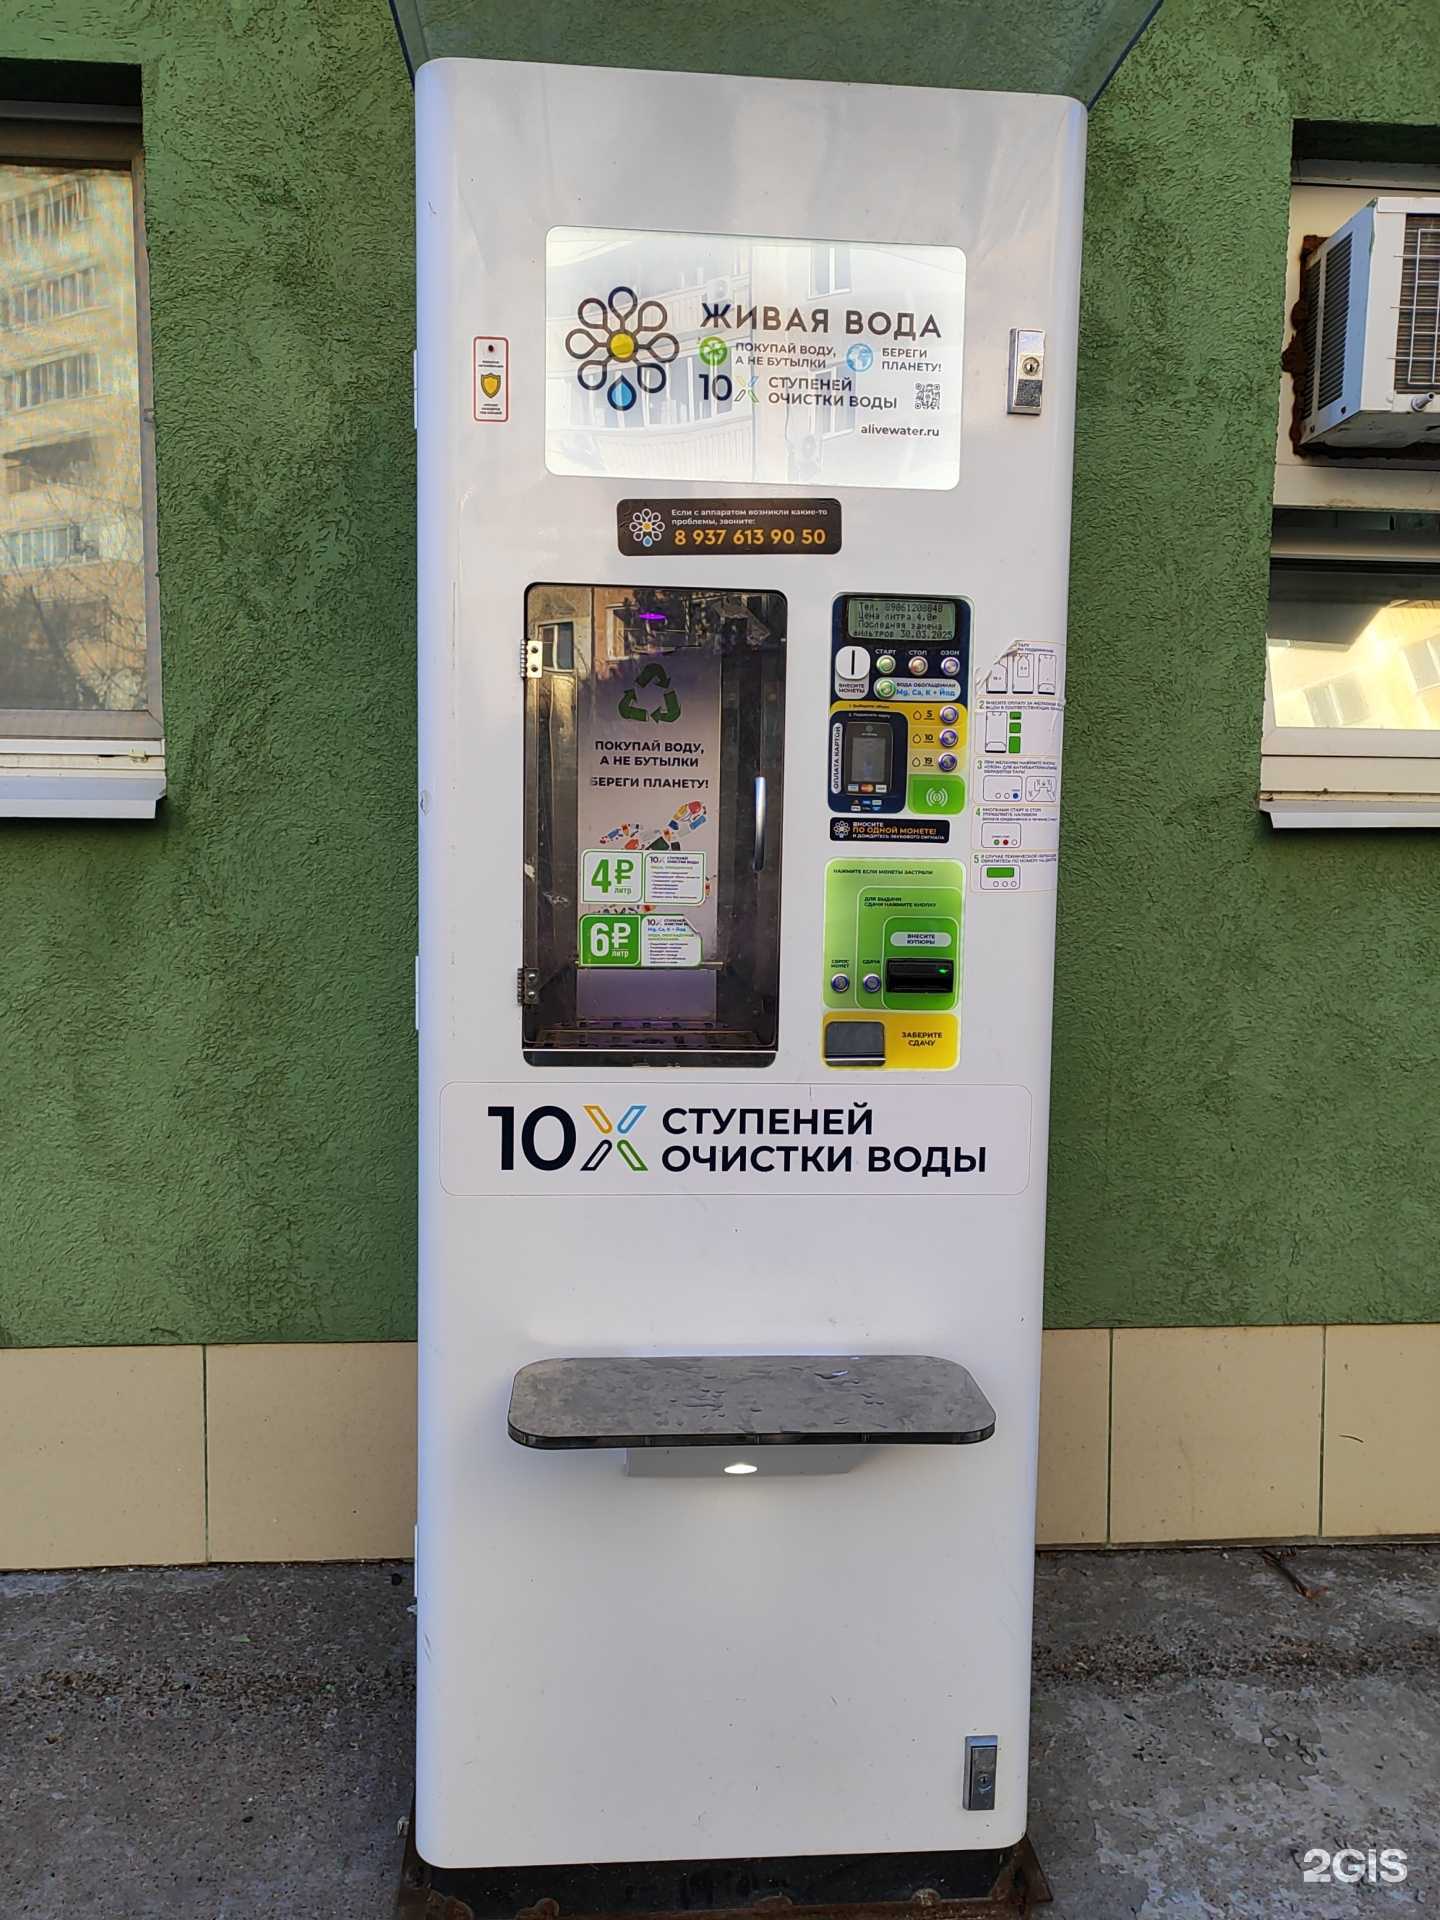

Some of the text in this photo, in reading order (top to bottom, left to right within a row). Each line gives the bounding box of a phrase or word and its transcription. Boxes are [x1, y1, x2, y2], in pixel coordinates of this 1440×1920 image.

[700, 302, 942, 341] ЖИВАЯ ВОДА
[735, 342, 837, 358] ПОКУПАЙ ВОДУ,
[882, 347, 927, 358] БЕРЕГИ
[735, 356, 826, 369] А НЕ БУТЫЛКИ
[881, 361, 942, 372] ПЛАНЕТУ!
[768, 376, 852, 392] СТУПЕНЕЙ
[768, 392, 897, 410] ОЧИСТКИ ВОДЫ
[861, 424, 939, 437] alivewater.ru
[671, 518, 718, 526] проблемы,
[674, 529, 826, 545] 8 937 613 90 50
[927, 710, 933, 718] 5
[595, 740, 704, 754] ПОКУПАЙ ВОДУ,
[600, 756, 699, 767] А НЕ БУТЫЛКИ
[591, 777, 709, 789] БЕРЕГИ ПЛАНЕТУ!
[867, 826, 898, 834] ОДНОЙ
[614, 887, 632, 895] литр
[612, 950, 629, 958] литр
[662, 1102, 873, 1136] СТУПЕНЕЙ
[662, 1145, 986, 1177] ОЧИСТКИ ВОДЫ
